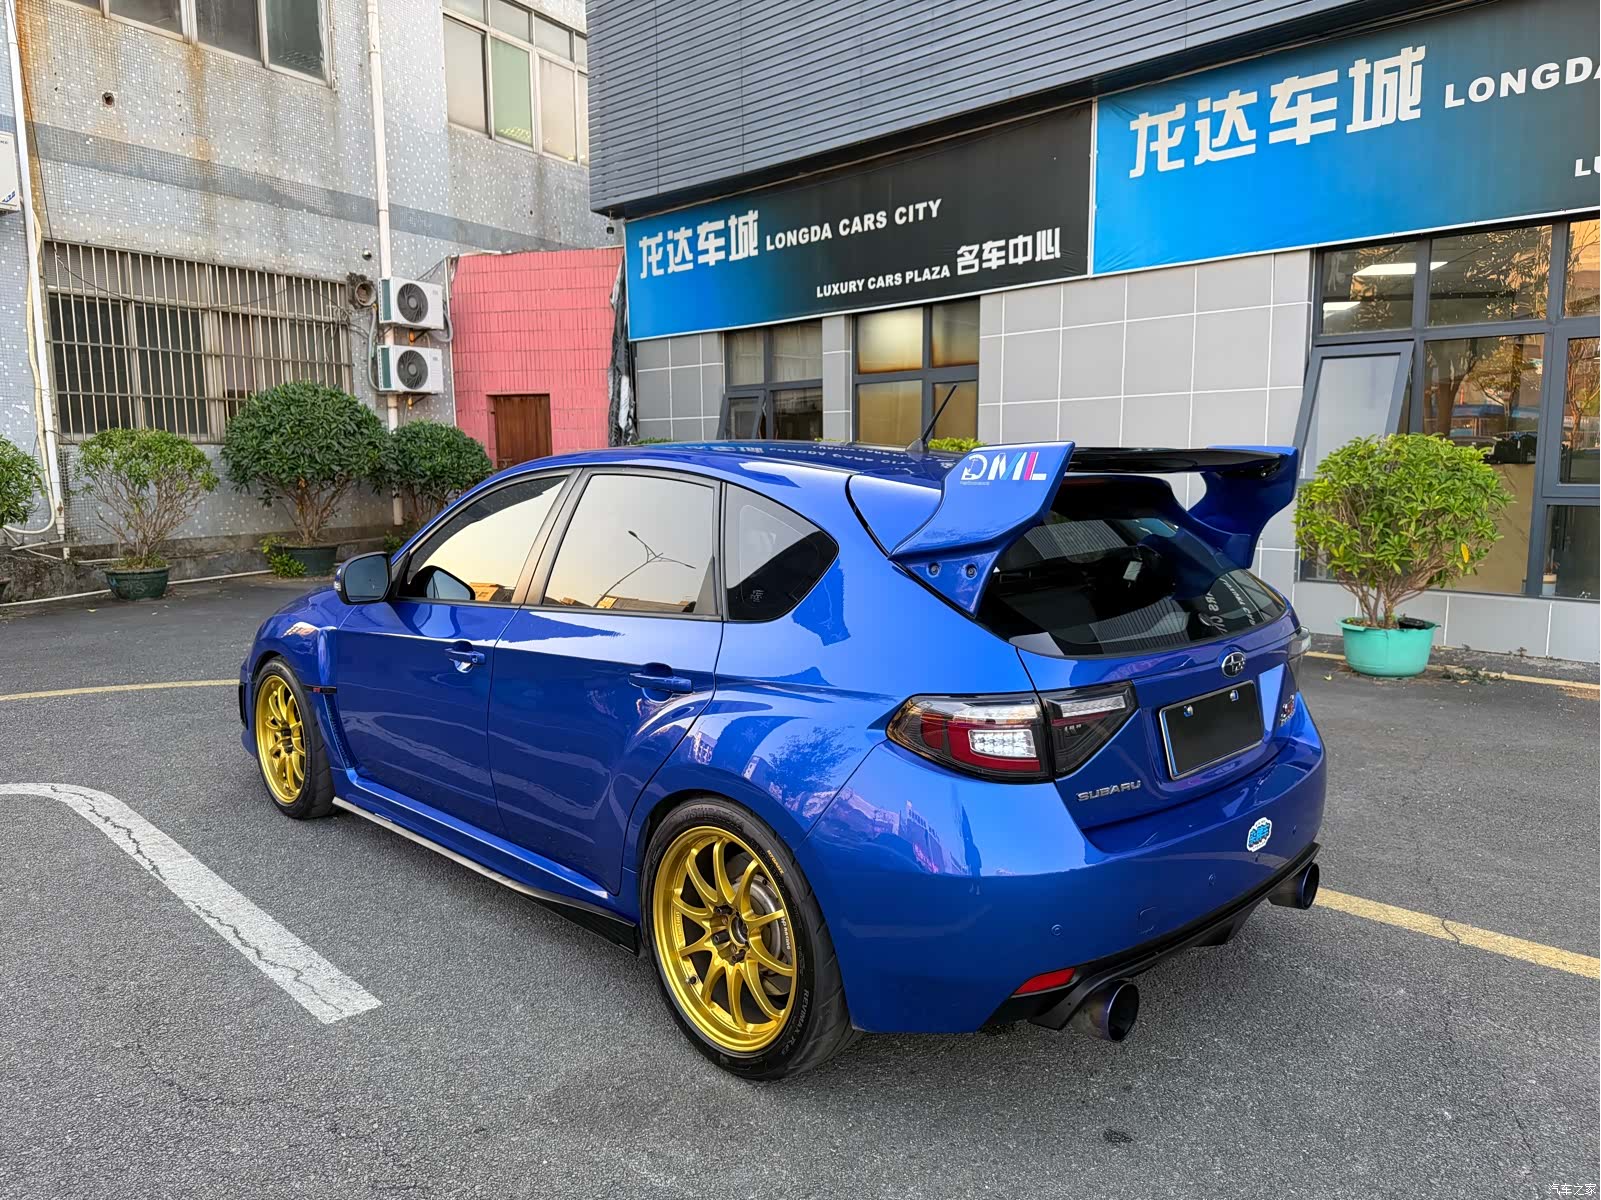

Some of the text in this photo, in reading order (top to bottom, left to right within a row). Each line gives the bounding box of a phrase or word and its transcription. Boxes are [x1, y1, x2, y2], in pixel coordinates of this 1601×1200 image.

[1129, 45, 1426, 179] 龙达车城
[639, 210, 759, 279] 龙达车城
[766, 198, 942, 251] LONGDA CARS CITY
[957, 228, 1061, 276] 名车中心
[816, 264, 951, 298] LUXURY CARS PLAZA
[961, 451, 1047, 481] DML
[1076, 780, 1141, 801] SUBARU
